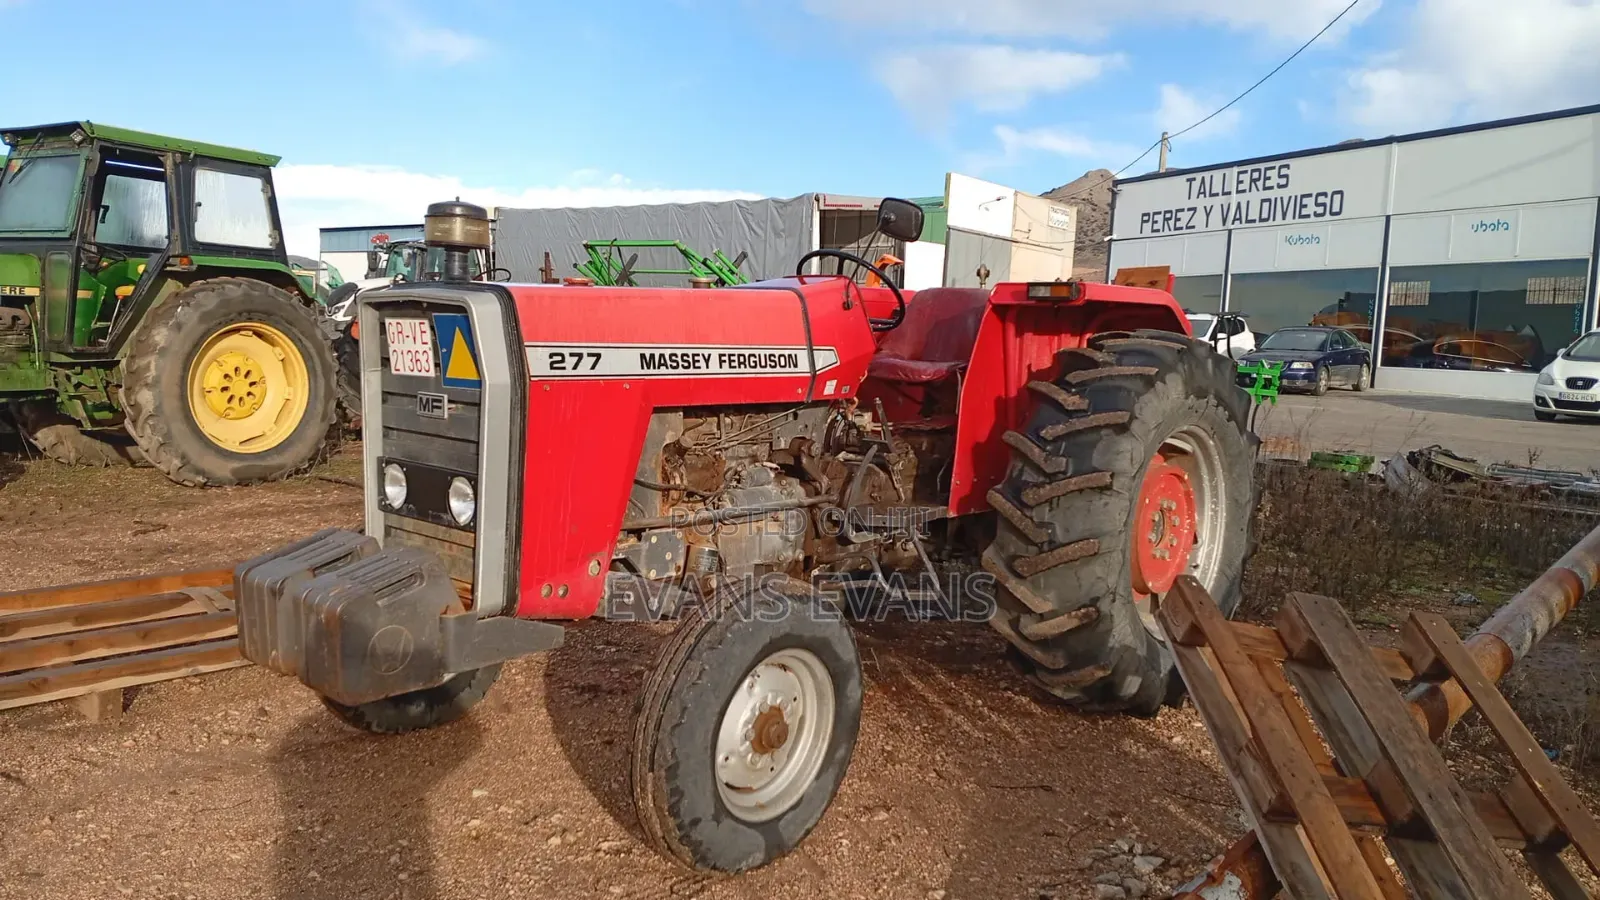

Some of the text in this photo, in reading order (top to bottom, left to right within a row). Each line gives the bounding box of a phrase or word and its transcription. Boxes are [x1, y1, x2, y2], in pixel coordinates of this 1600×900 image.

[1186, 164, 1290, 200] TALLERES
[1140, 190, 1344, 234] PEREZ Y VALDIVIESO
[1285, 234, 1320, 245] Kubota
[387, 321, 429, 346] GR-VE
[392, 349, 431, 374] 21363
[549, 352, 602, 371] 277
[640, 352, 799, 370] MASSEY FERGUSON
[419, 397, 443, 413] MF
